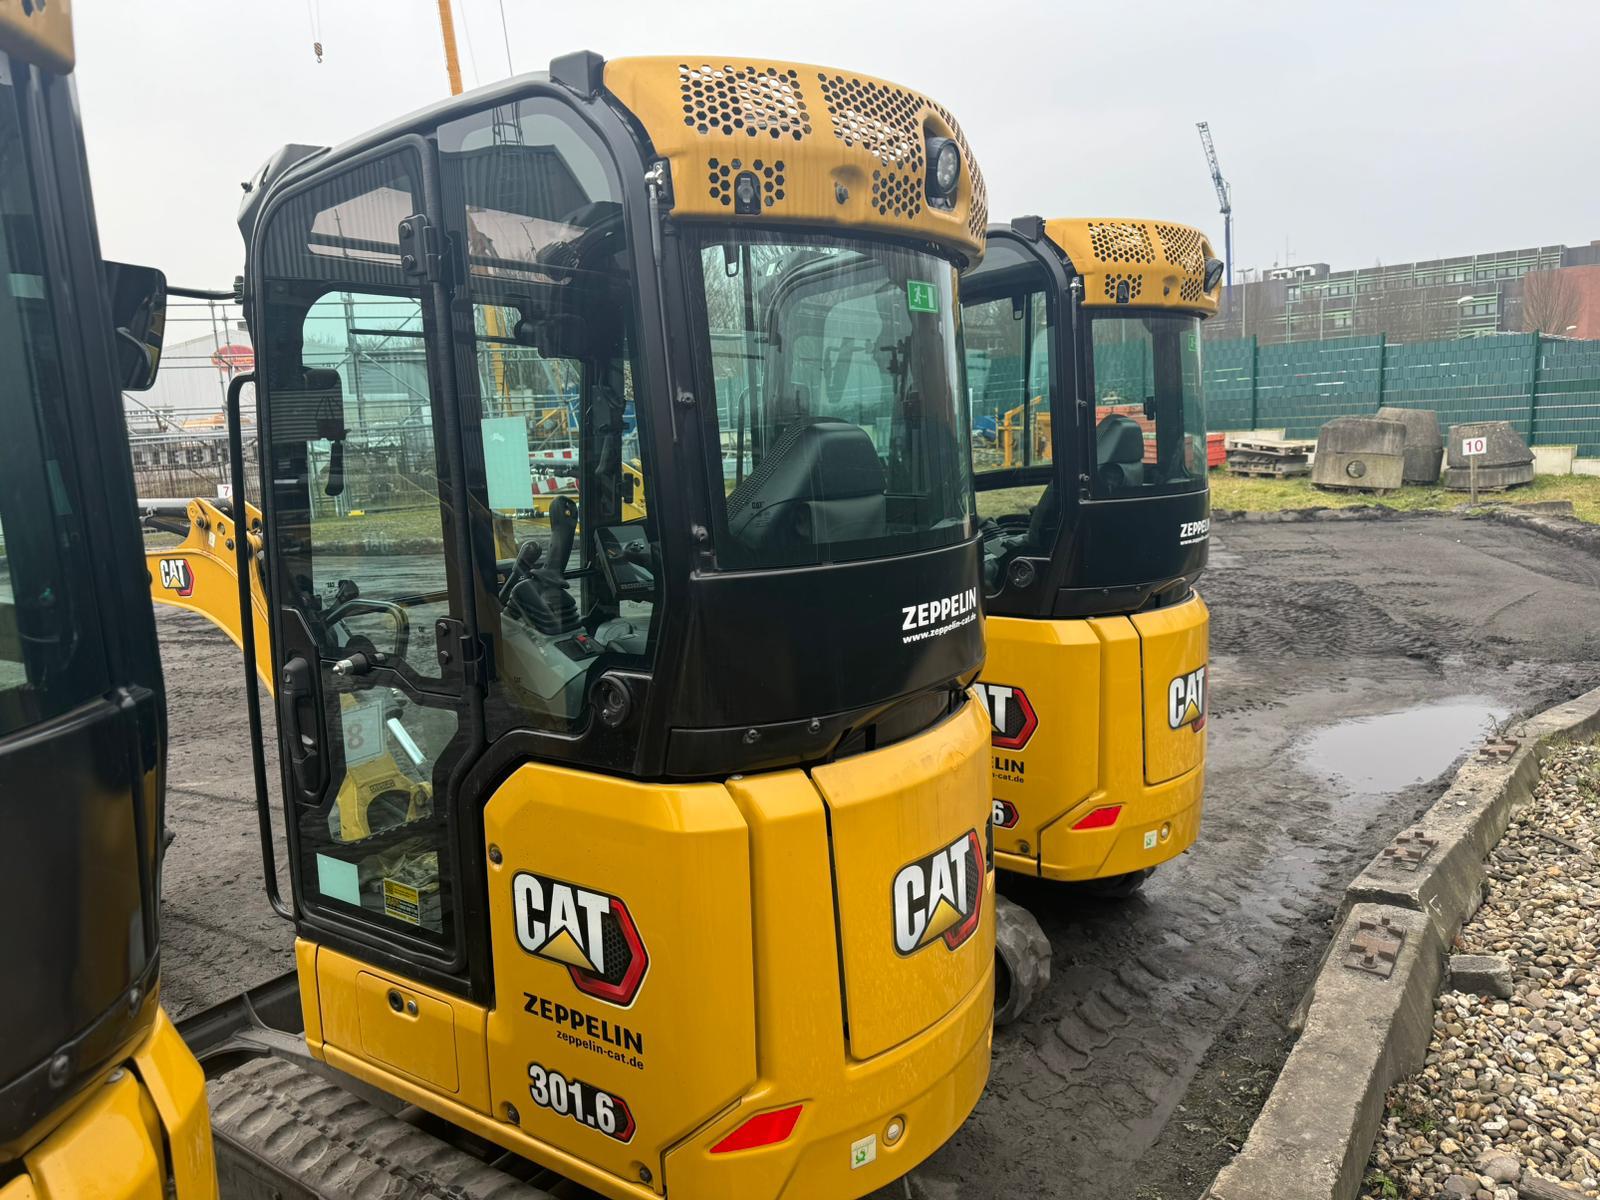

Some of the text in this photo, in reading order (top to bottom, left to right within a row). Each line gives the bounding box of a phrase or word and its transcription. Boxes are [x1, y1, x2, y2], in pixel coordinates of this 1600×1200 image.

[1466, 440, 1484, 453] 10
[222, 485, 230, 497] 7
[160, 559, 185, 588] CAT
[902, 586, 977, 631] ZEPPELIN
[902, 611, 977, 644] www.zeppelin-cat.de
[1169, 667, 1205, 729] CAT
[894, 834, 970, 952] CAT
[513, 873, 610, 975] CAT
[523, 991, 644, 1055] ZEPPELIN
[556, 1030, 645, 1071] zeppelin-cat.de
[529, 1064, 616, 1134] 301.6
